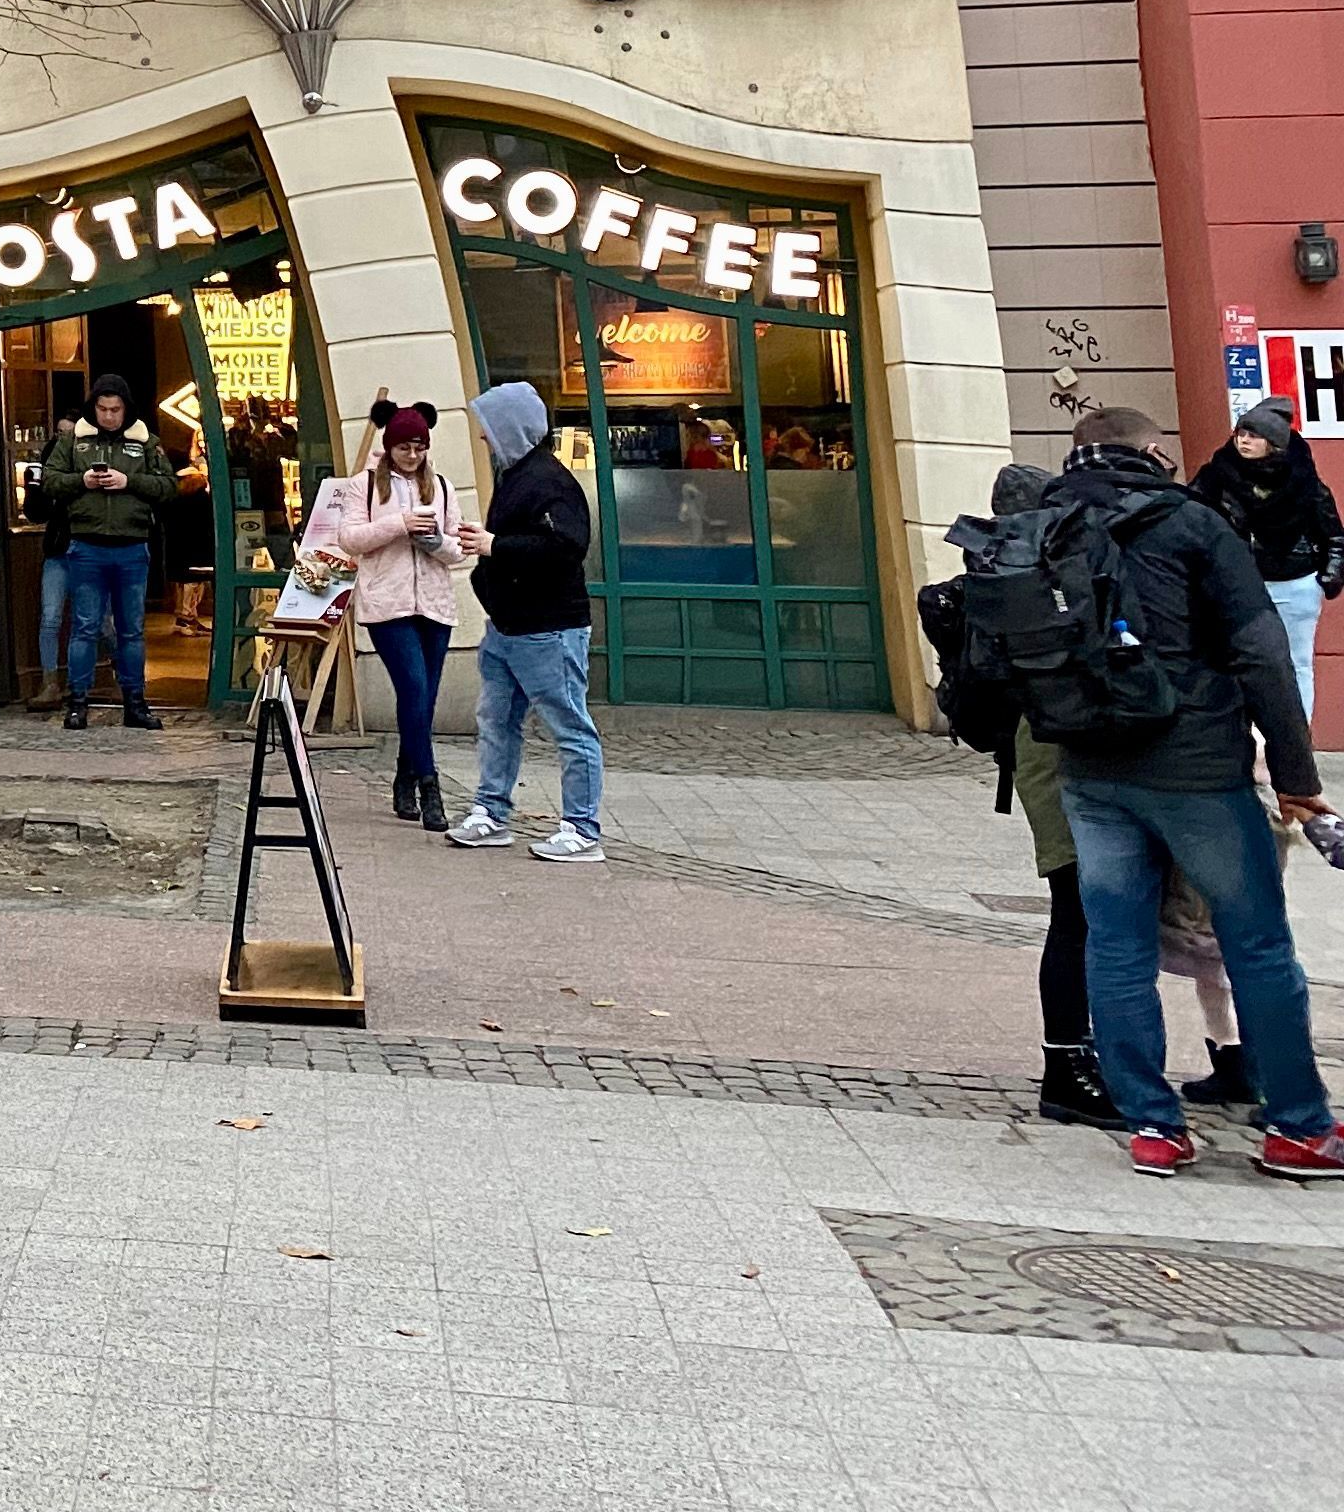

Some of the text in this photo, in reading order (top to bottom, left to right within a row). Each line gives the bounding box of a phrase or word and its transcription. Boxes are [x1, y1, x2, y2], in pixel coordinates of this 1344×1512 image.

[442, 157, 822, 298] COFFEE
[200, 296, 286, 320] WOLNYCH
[206, 322, 286, 338] MIEJSC
[575, 313, 712, 346] elcome
[213, 352, 280, 369] MORE
[216, 371, 280, 387] FREE
